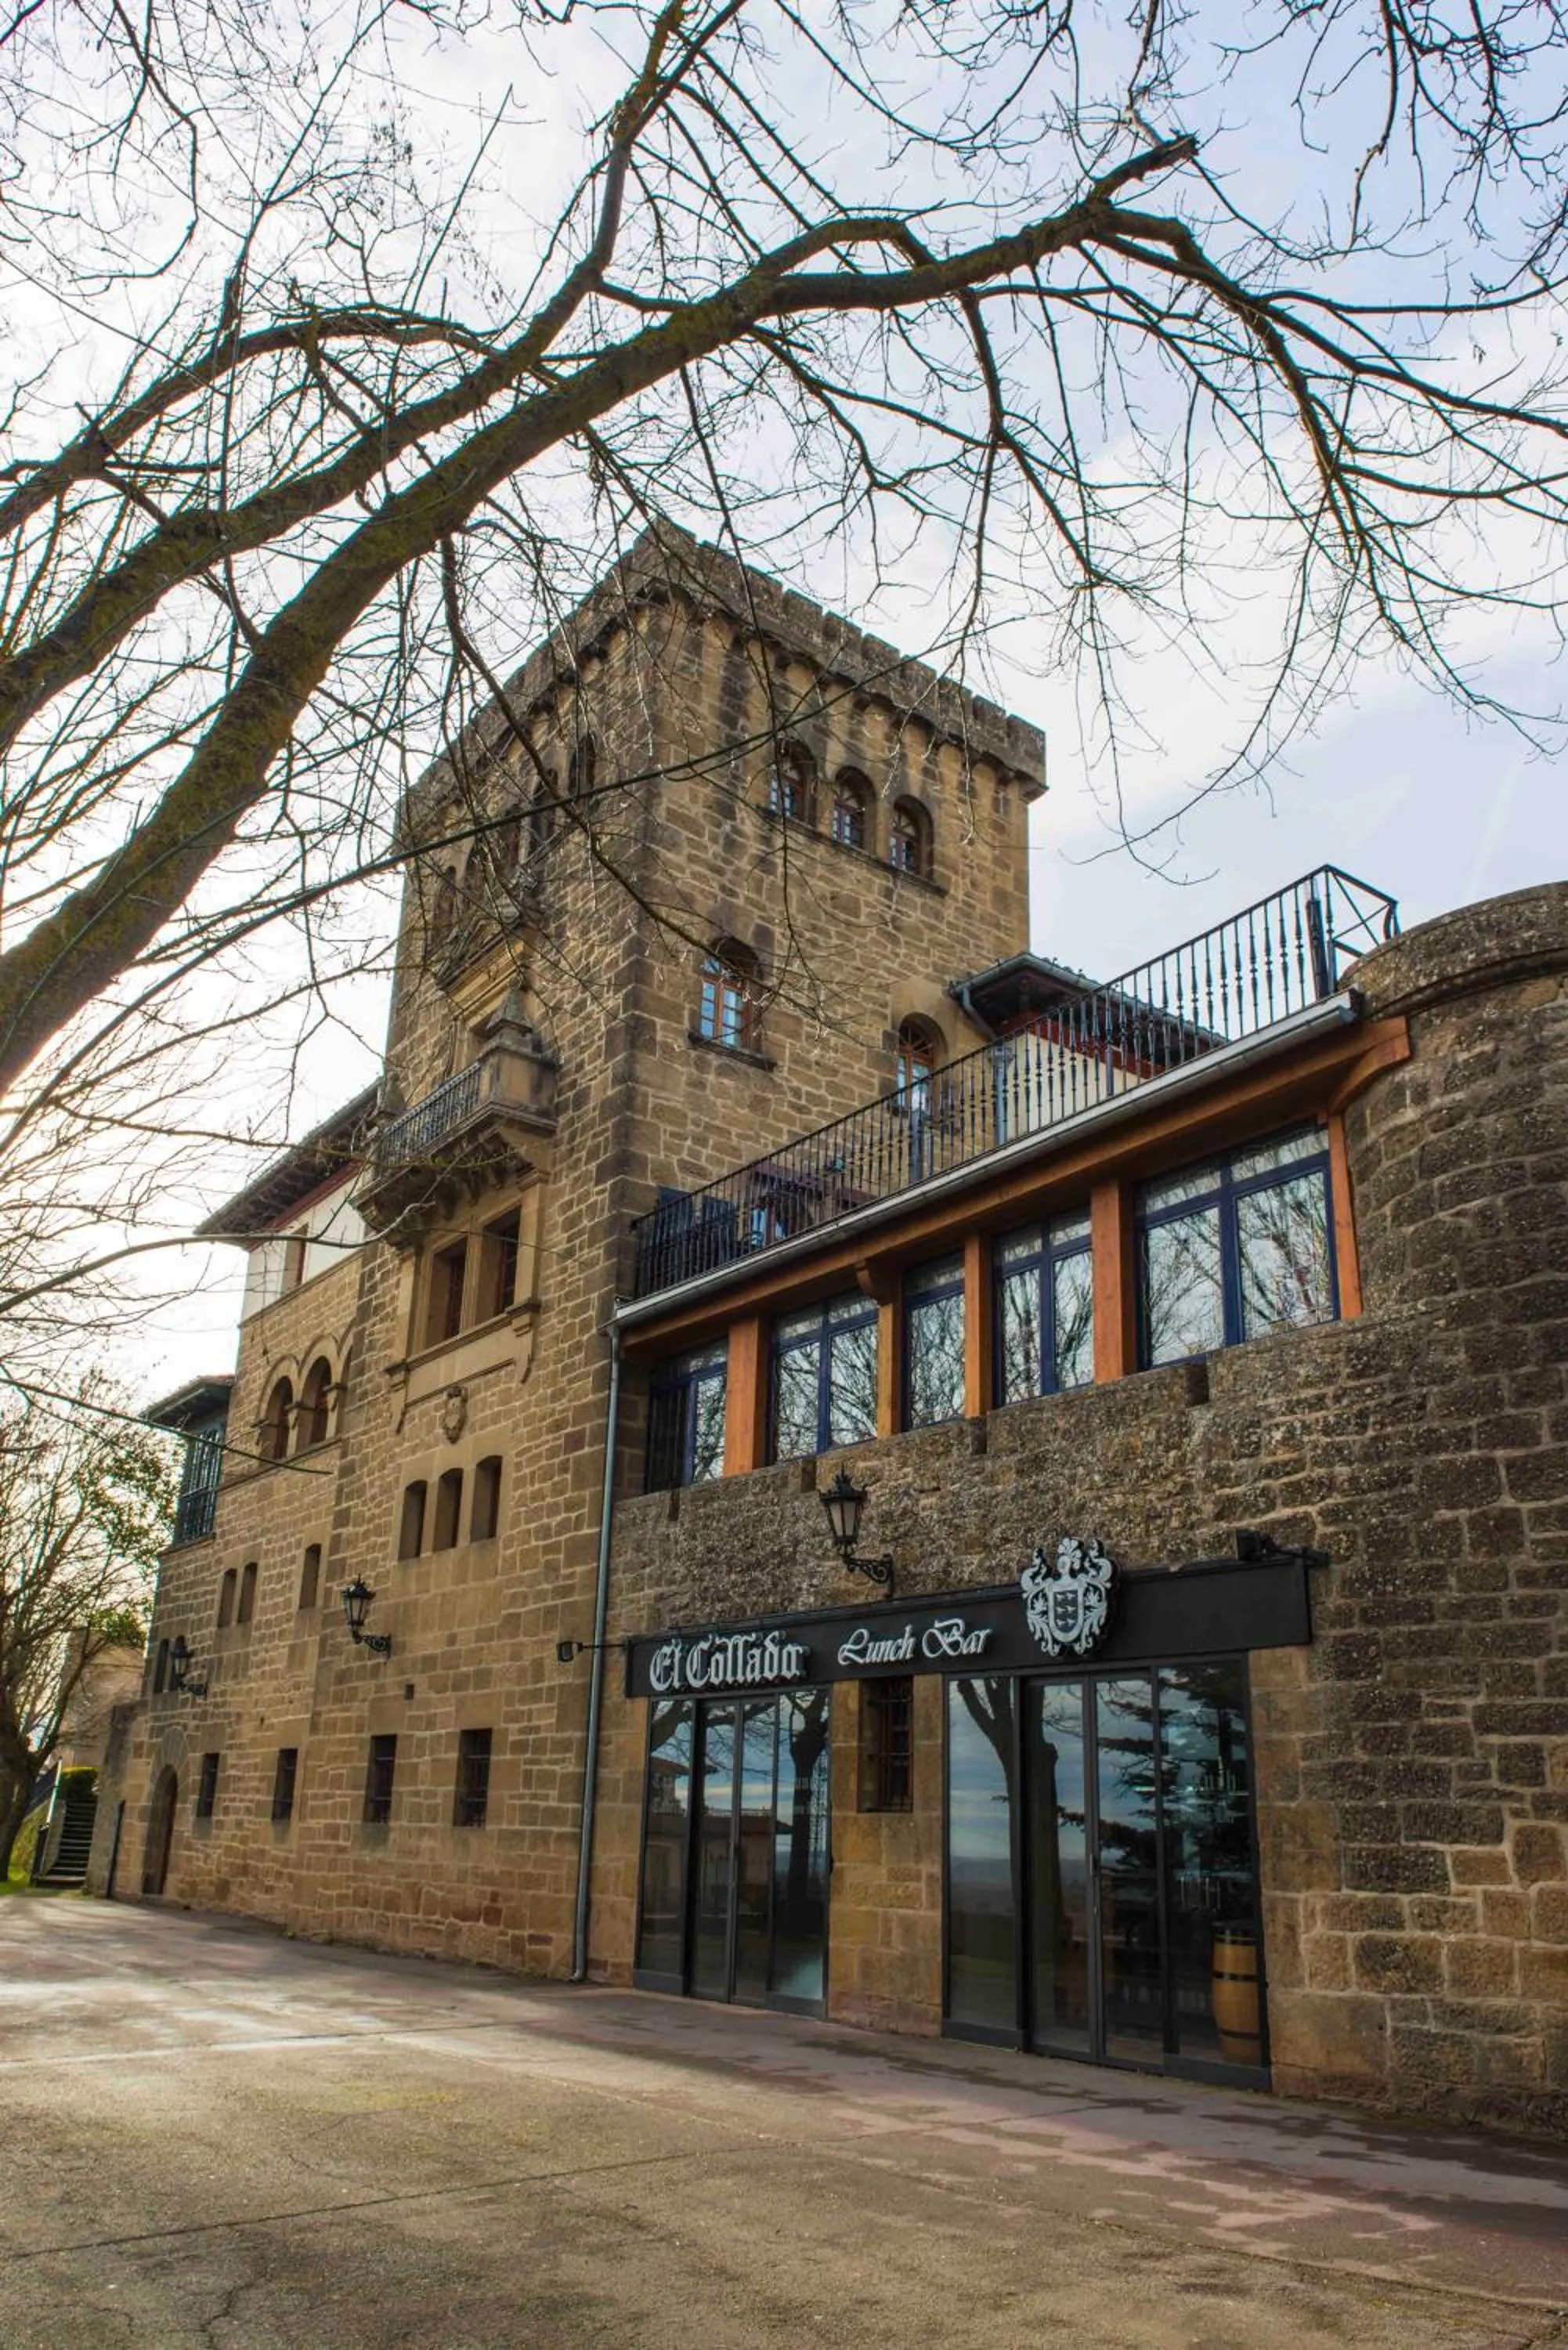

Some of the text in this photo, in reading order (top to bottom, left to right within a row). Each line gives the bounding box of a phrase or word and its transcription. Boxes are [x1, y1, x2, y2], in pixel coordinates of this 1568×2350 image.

[649, 1631, 804, 1692] El Collado
[837, 1618, 992, 1665] Lunch Bar
